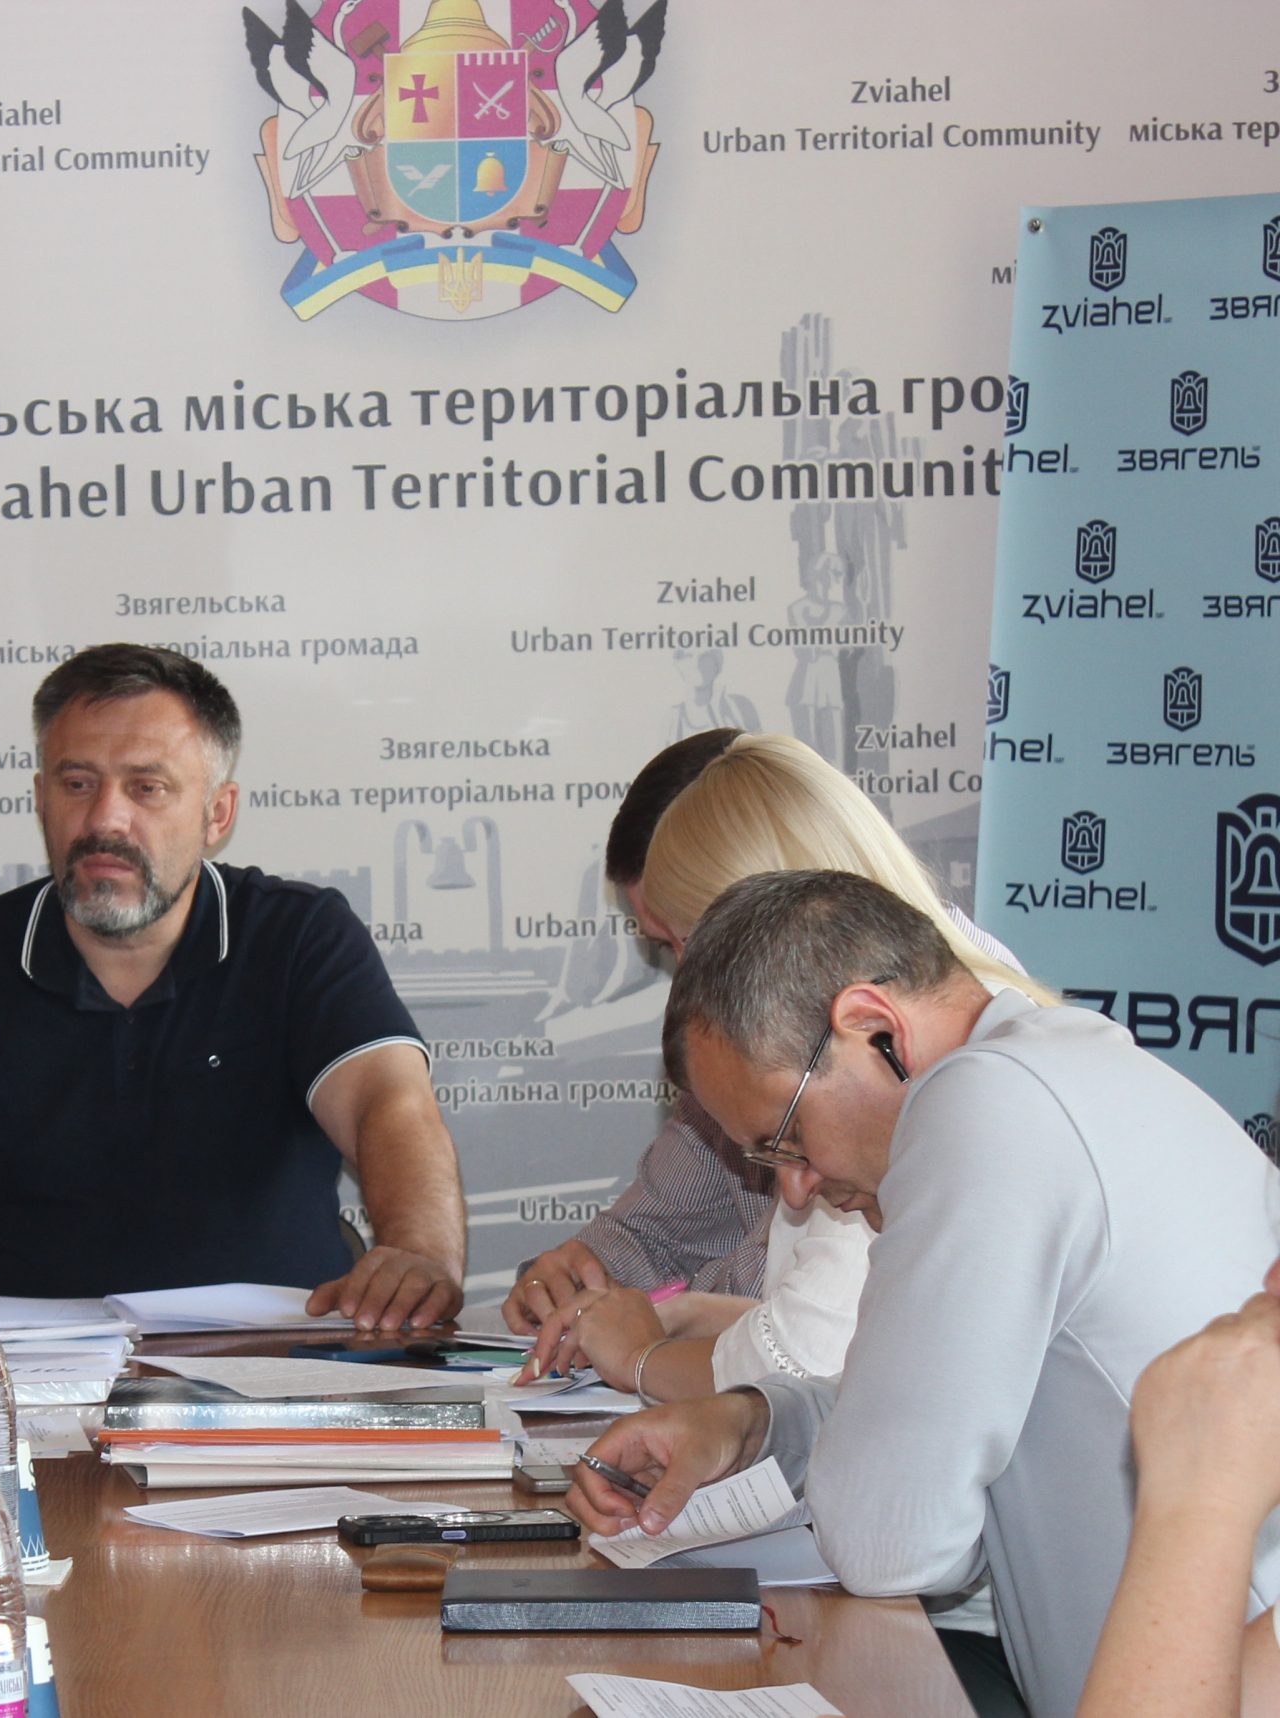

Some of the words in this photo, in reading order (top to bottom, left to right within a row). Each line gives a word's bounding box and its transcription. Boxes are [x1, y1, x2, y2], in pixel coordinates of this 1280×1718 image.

[851, 76, 950, 103] Zviahel
[704, 127, 785, 153] Urban
[796, 122, 932, 150] Territorial
[944, 120, 1100, 152] Community
[1130, 117, 1222, 141] міська
[55, 143, 209, 175] Community
[186, 380, 391, 431] міська
[411, 368, 880, 441] територіальна
[151, 461, 331, 515] Urban
[353, 450, 665, 510] Territorial
[689, 445, 1004, 502] Communit
[658, 576, 755, 603] Zviahel
[116, 594, 285, 616] Звягельська
[512, 627, 592, 652] Urban
[602, 622, 737, 650] Territorial
[749, 620, 904, 651] Community
[302, 637, 418, 664] громада
[380, 738, 550, 759] Звягельська
[856, 723, 956, 750] Zviahel
[856, 768, 938, 794] itorial
[250, 784, 340, 807] міська
[351, 779, 554, 812] територіальна
[516, 913, 596, 938] Urban
[520, 1196, 600, 1222] Urban
